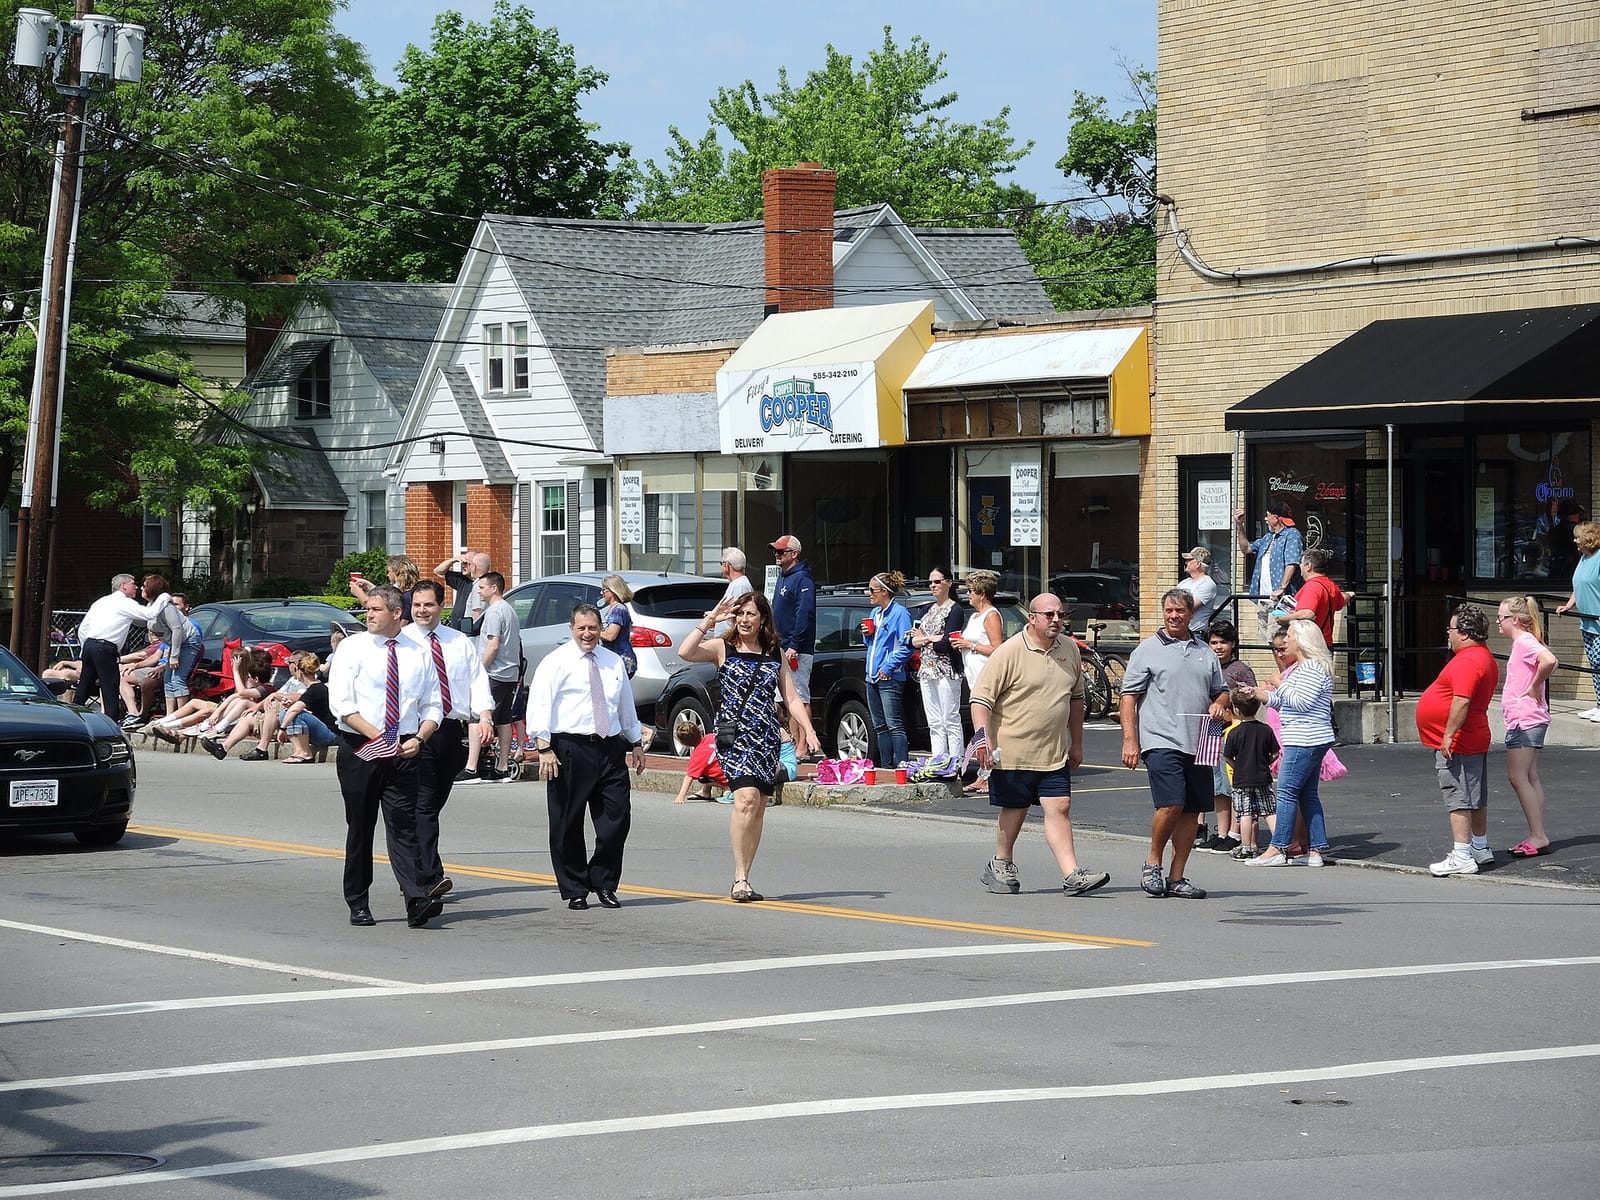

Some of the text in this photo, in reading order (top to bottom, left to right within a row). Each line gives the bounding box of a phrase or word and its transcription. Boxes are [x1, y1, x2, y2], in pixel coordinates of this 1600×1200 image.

[812, 369, 858, 380] 585-342-2110
[774, 382, 793, 396] COOPER
[760, 392, 833, 433] COOPER
[788, 419, 805, 438] Deli
[734, 437, 765, 449] DELIVERY
[829, 432, 863, 444] CATERING
[1016, 468, 1038, 480] COOPER
[623, 476, 640, 486] COOPER
[1268, 477, 1309, 493] Budweiser
[1535, 482, 1574, 503] Corona
[1200, 494, 1229, 504] SECURITY
